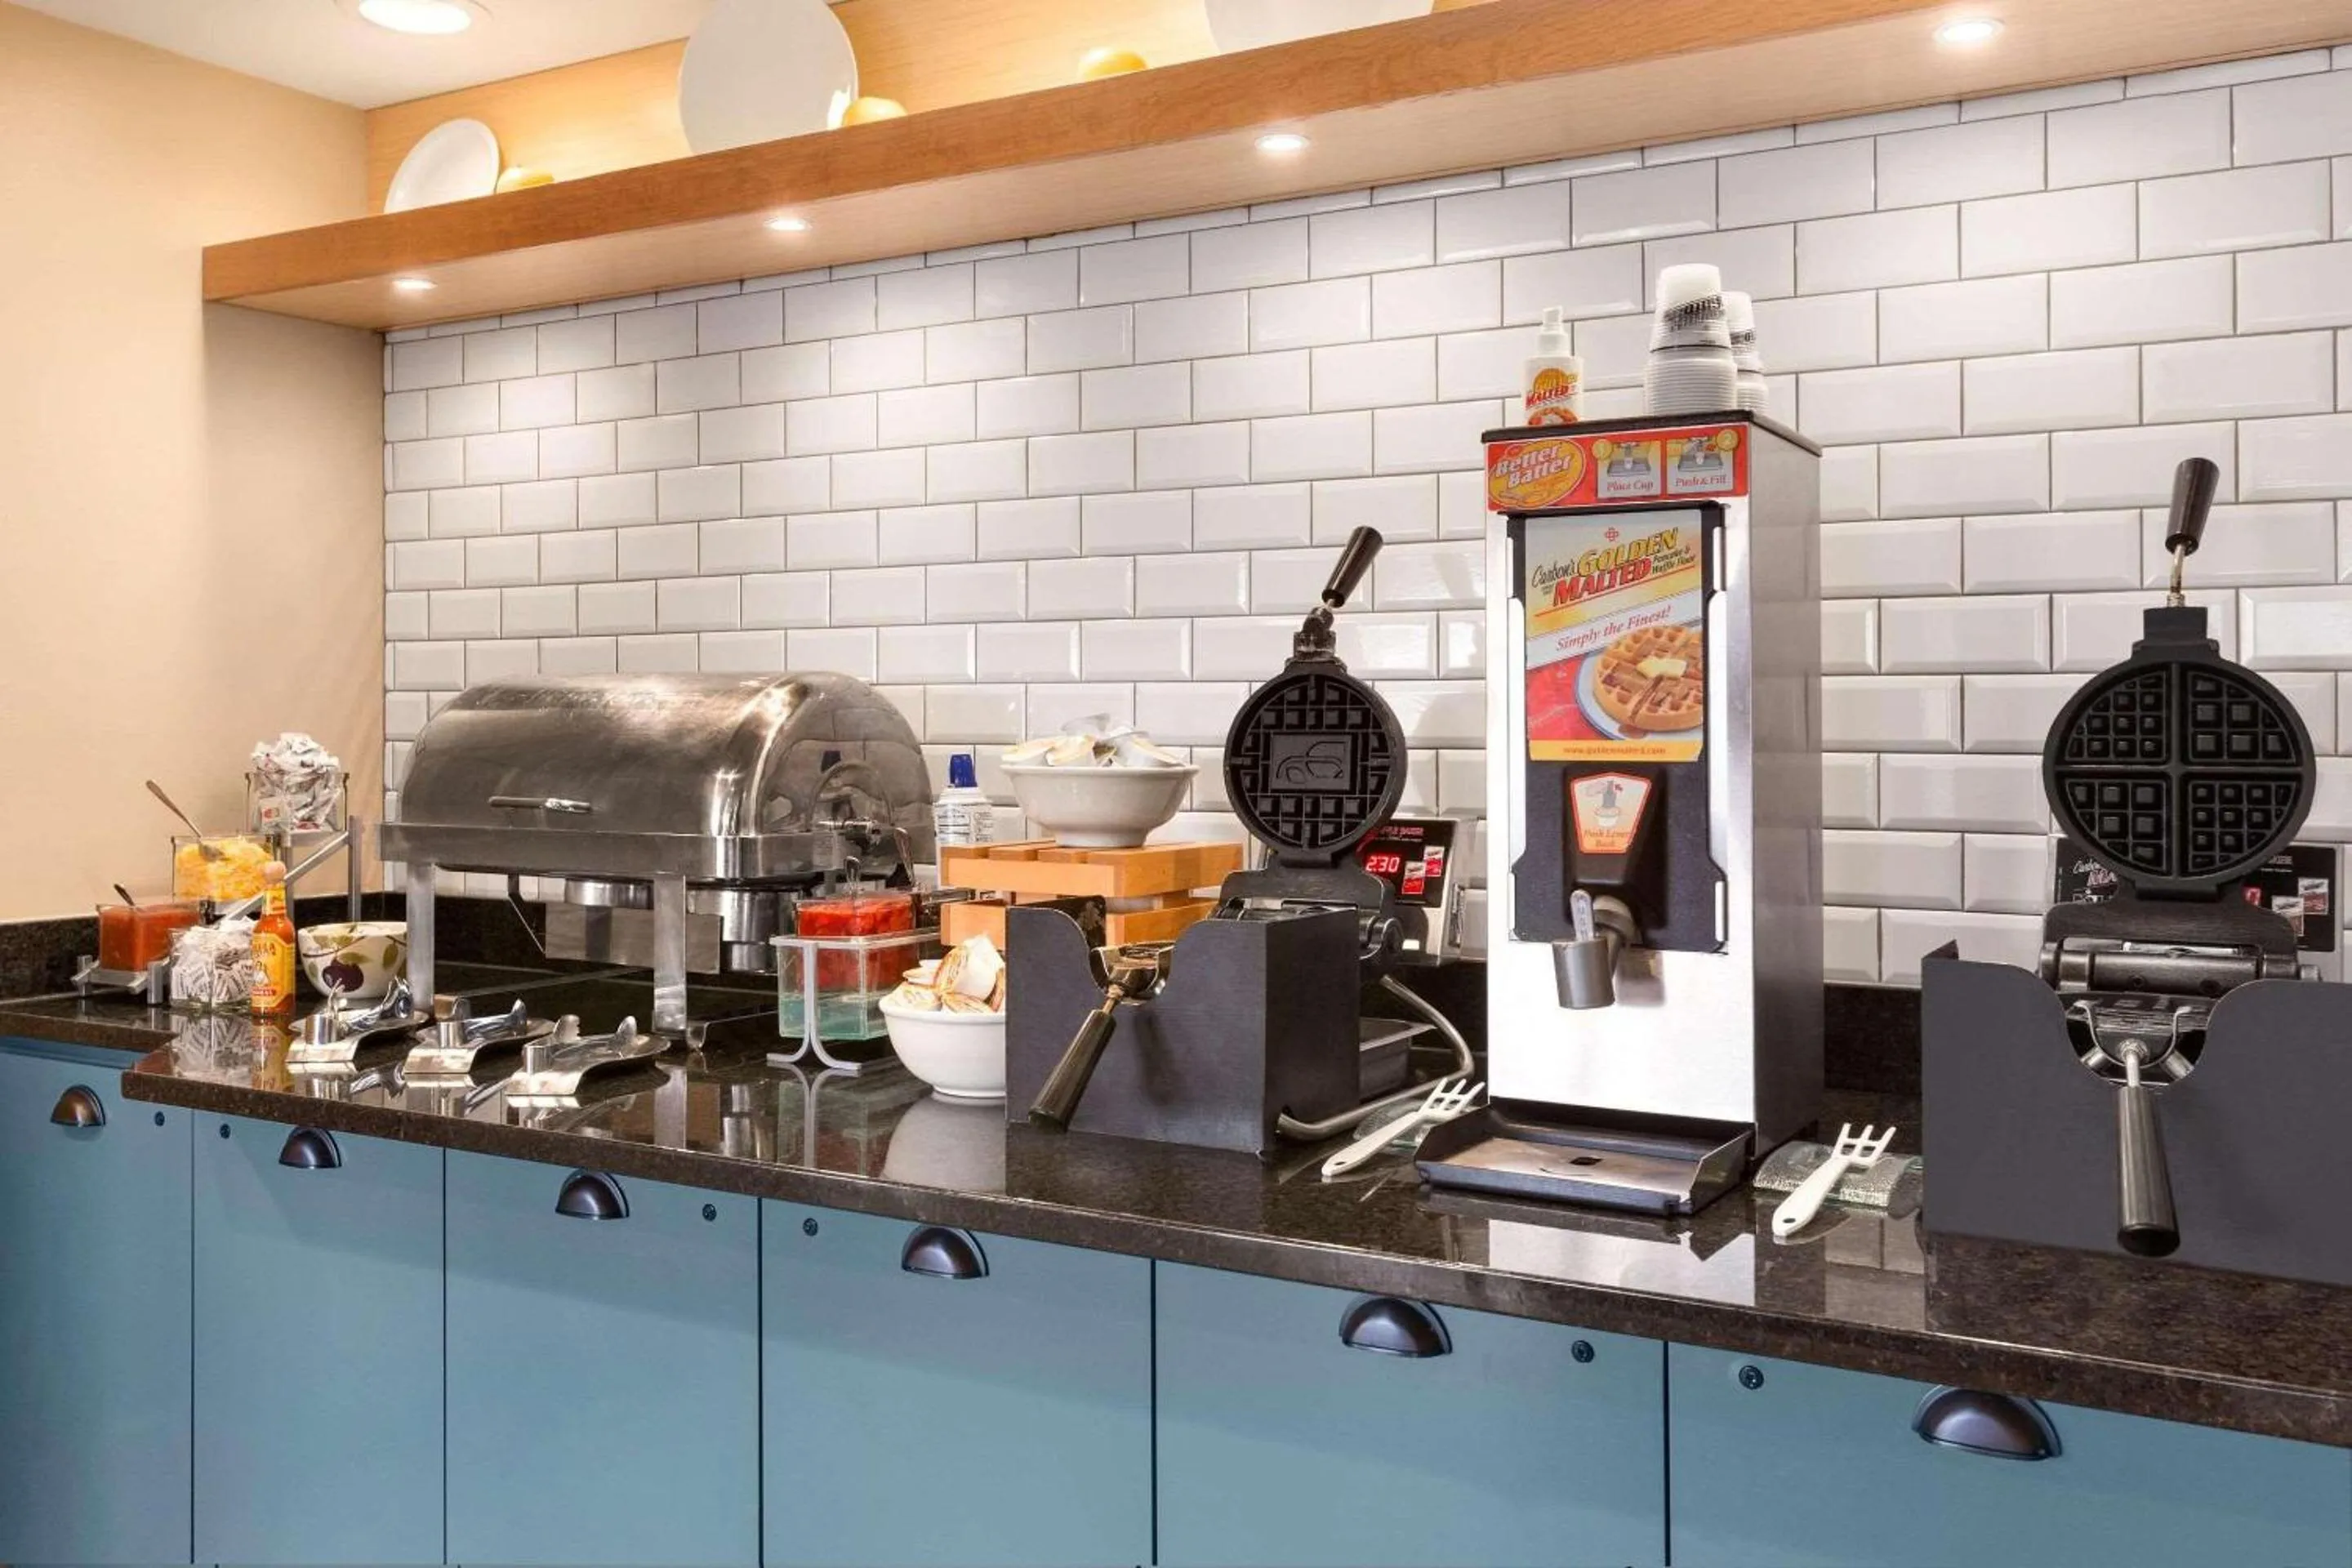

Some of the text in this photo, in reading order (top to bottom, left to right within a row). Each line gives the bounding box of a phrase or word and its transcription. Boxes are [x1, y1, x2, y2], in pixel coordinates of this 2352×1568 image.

[1495, 443, 1561, 478] Better
[1507, 454, 1572, 488] Batter
[1606, 479, 1654, 492] Place Cup
[1577, 526, 1679, 577] GOLDEN
[1552, 557, 1652, 608] MALTED
[1556, 604, 1671, 652] Simply the Finest!
